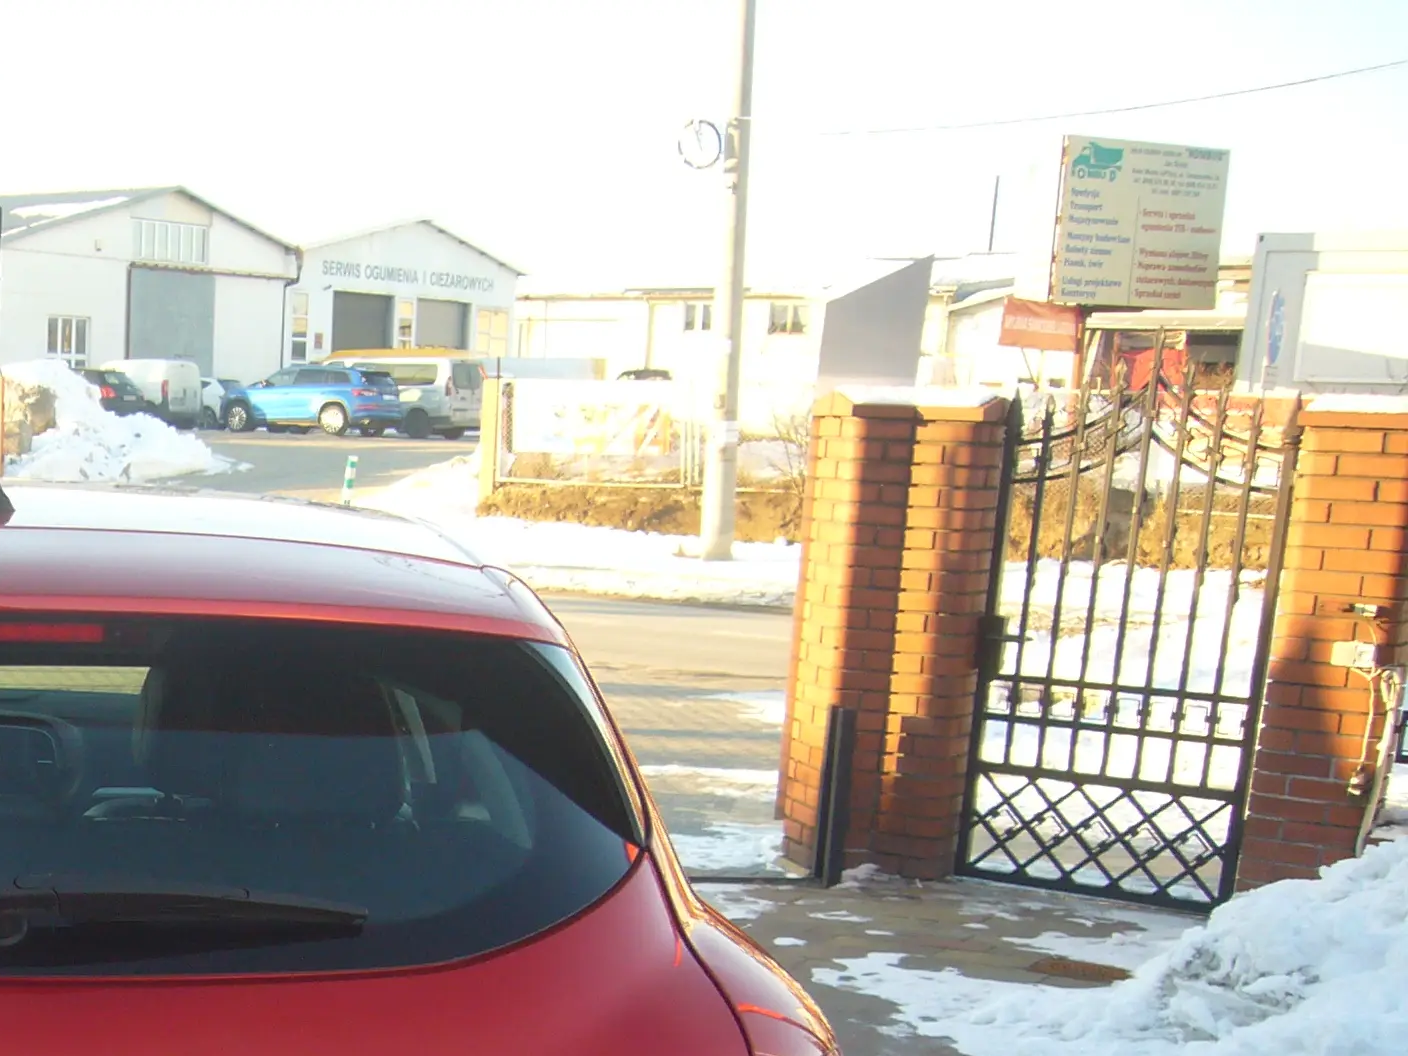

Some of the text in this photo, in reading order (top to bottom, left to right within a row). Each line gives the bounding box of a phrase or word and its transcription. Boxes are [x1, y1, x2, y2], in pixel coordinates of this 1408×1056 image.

[322, 259, 361, 279] SERWIS
[364, 264, 419, 285] OGUMIENIA
[423, 270, 428, 285] I
